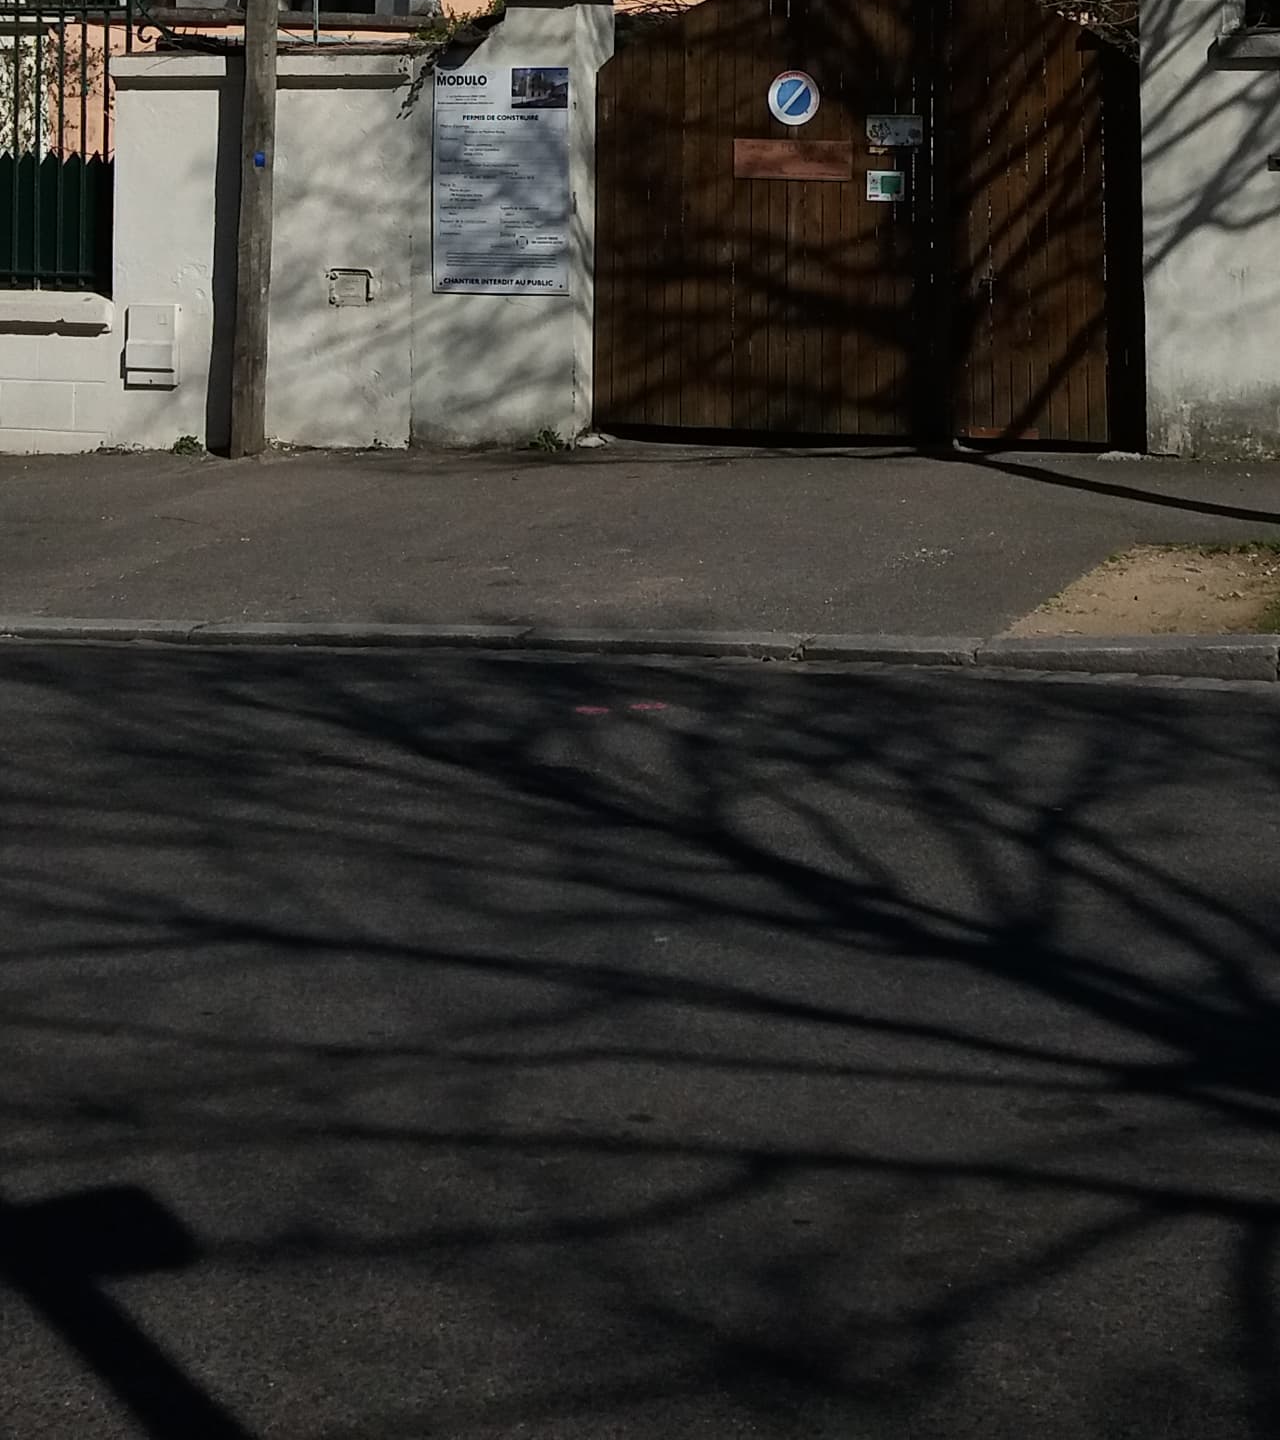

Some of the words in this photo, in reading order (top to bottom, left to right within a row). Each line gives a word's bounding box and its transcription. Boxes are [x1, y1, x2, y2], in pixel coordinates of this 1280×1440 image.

[437, 75, 487, 86] MODULO
[443, 277, 479, 285] CHANTIER
[481, 278, 513, 286] INTERDIT
[527, 279, 553, 287] PUBLIC
